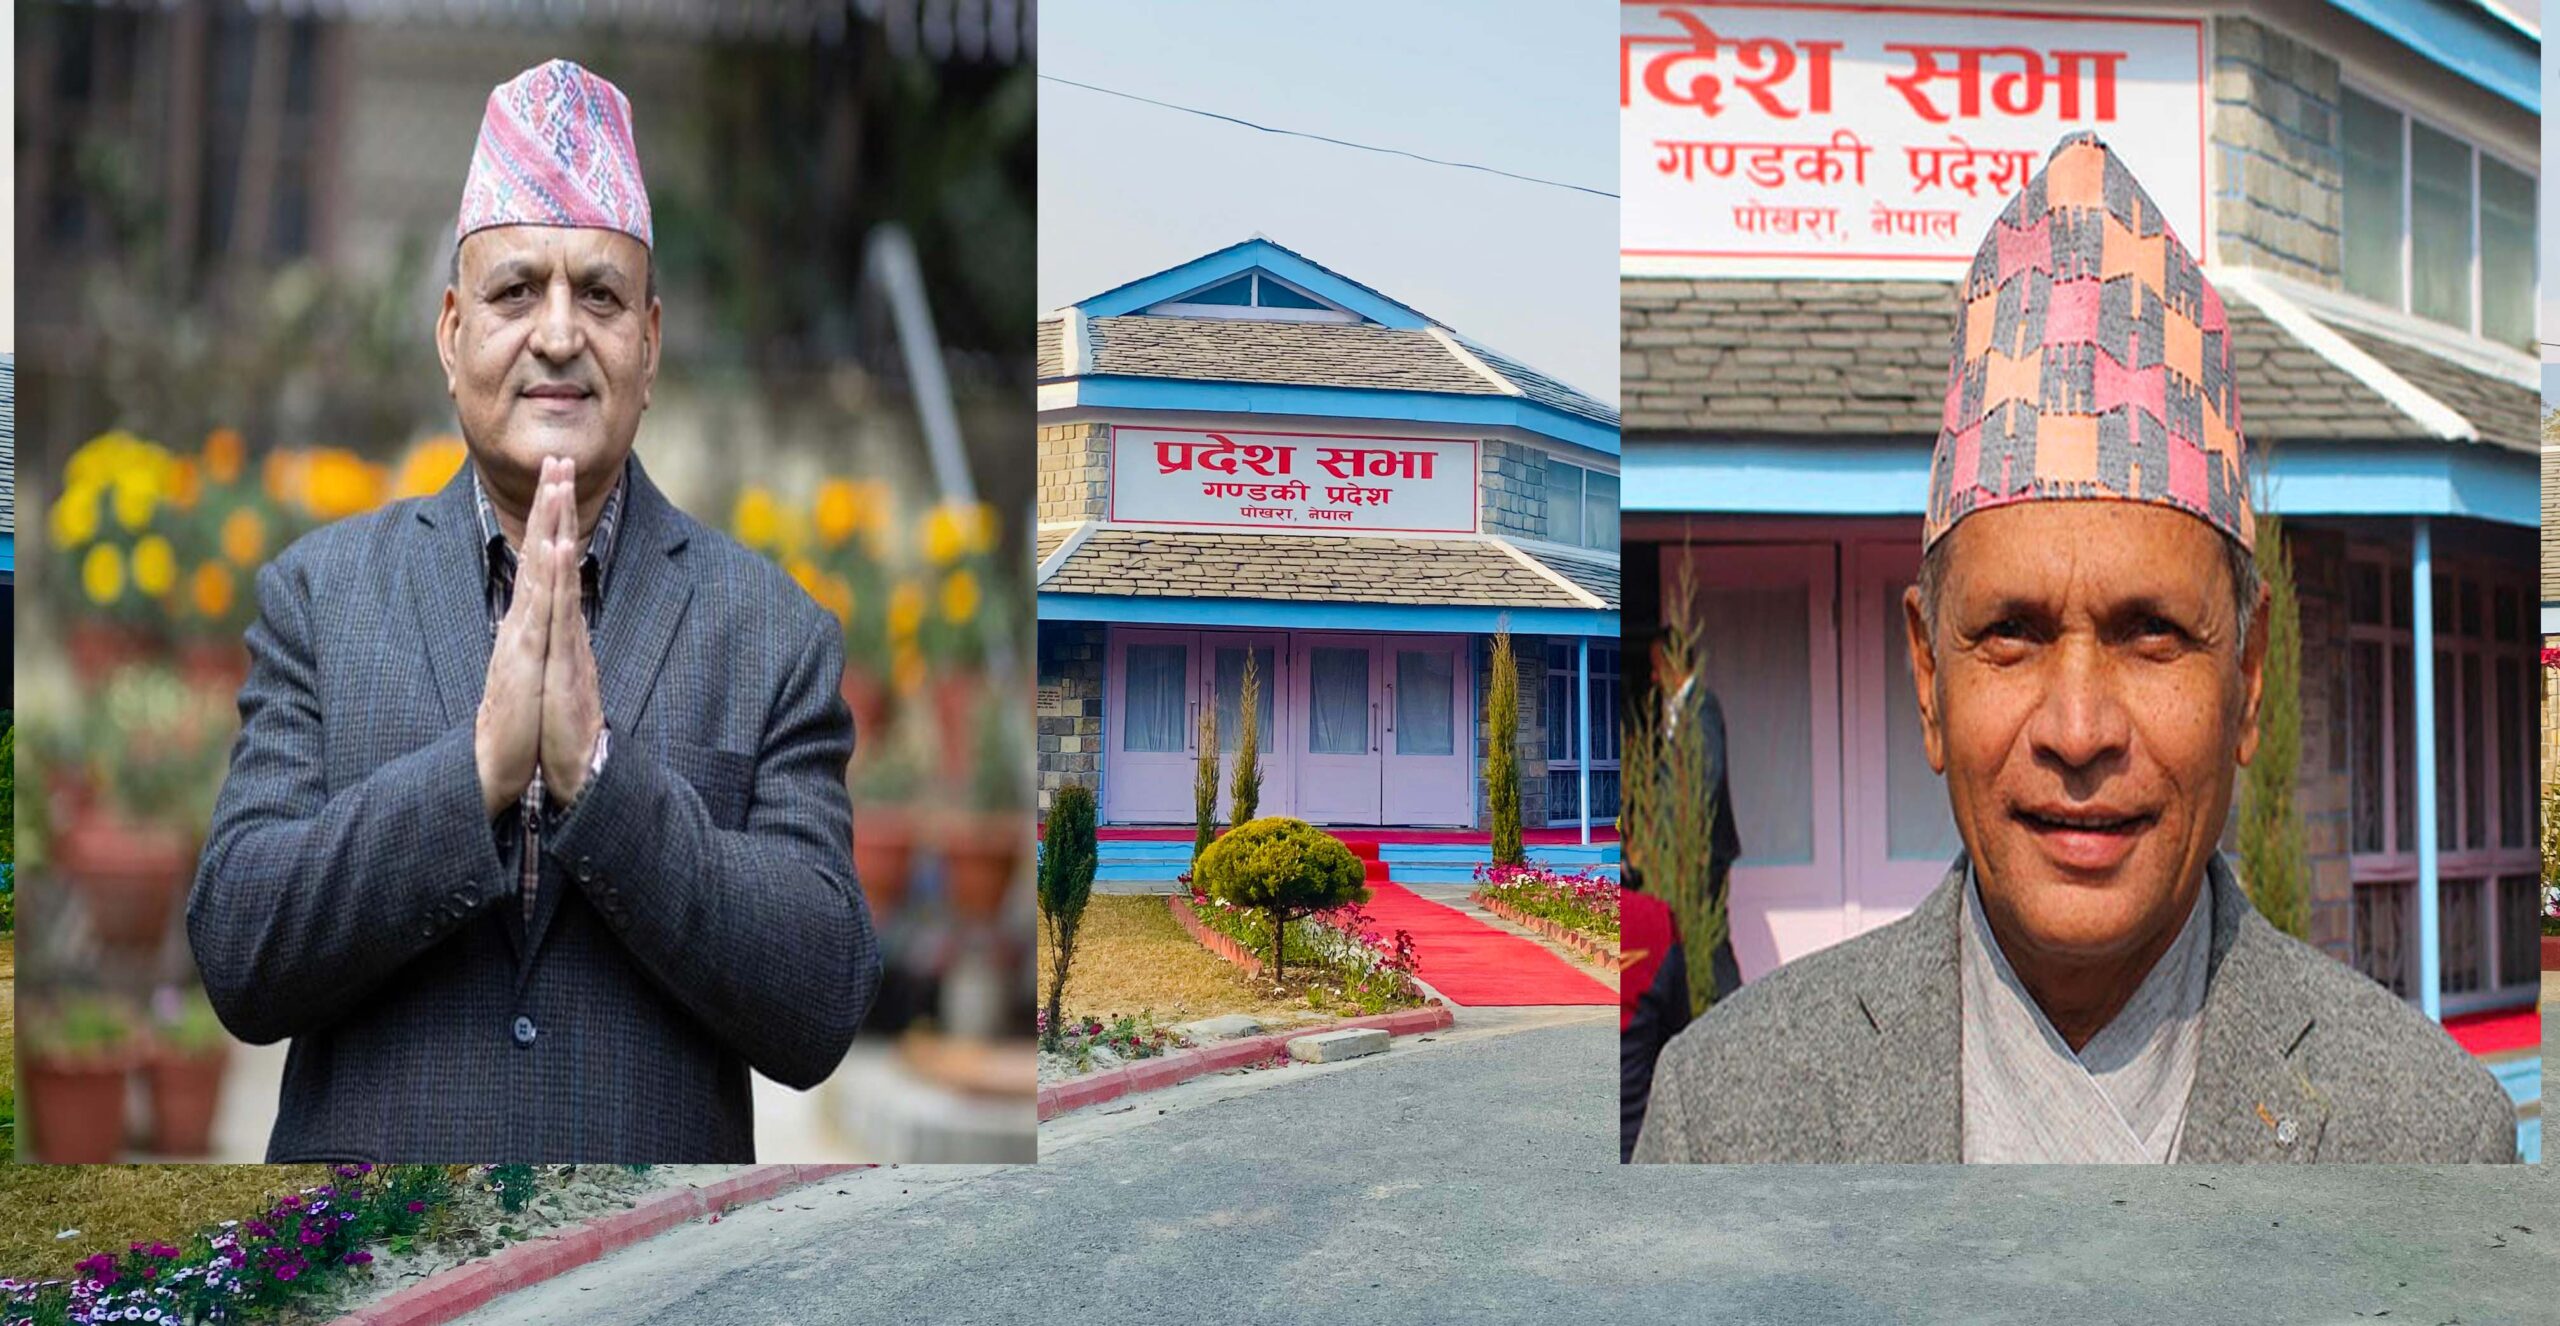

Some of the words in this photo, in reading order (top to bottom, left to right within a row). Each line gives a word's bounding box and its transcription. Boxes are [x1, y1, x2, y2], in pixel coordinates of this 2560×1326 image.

[1884, 43, 2128, 124] सभा
[1653, 128, 1875, 189] गण्डकी
[1903, 134, 2039, 197] प्रदेश
[1732, 198, 1849, 242] पोखरा,
[1870, 201, 1961, 239] नेपाल
[1153, 433, 1297, 477] प्रदेश
[1316, 447, 1438, 480] सभा
[1203, 480, 1311, 502] गण्डकी
[1325, 482, 1393, 507] प्रदेश
[1240, 505, 1299, 522] पोखरा,
[1308, 507, 1354, 522] नेपाल
